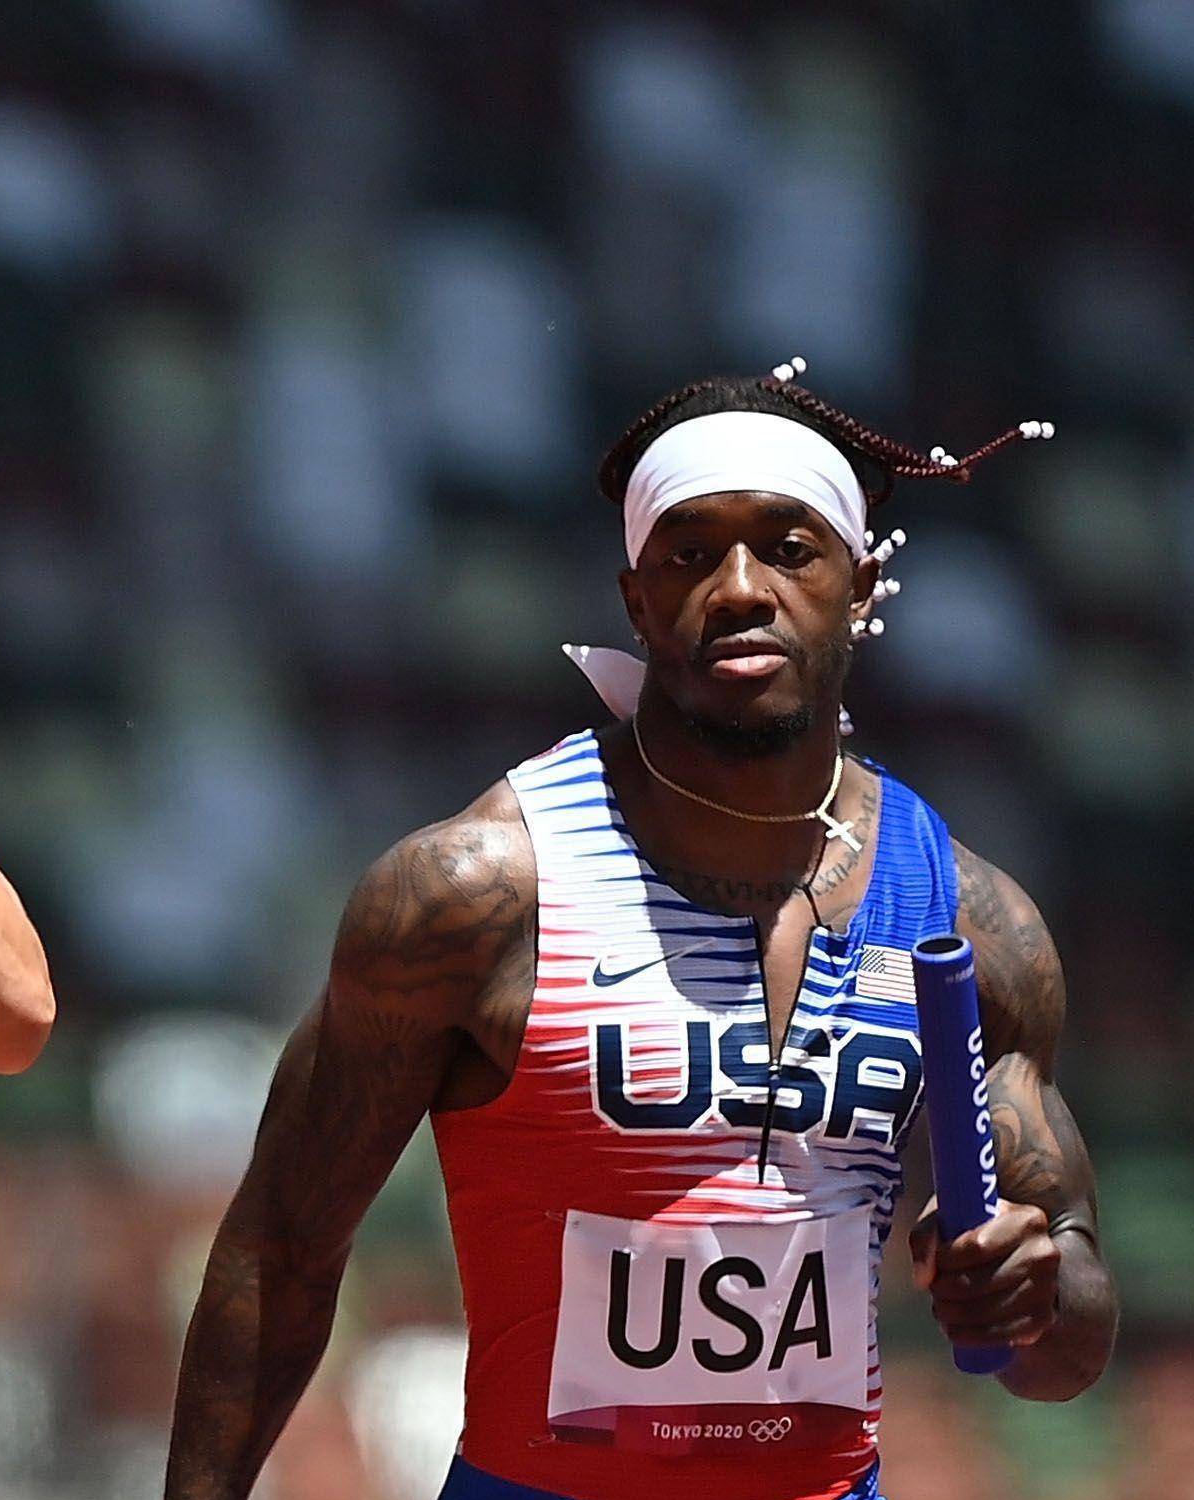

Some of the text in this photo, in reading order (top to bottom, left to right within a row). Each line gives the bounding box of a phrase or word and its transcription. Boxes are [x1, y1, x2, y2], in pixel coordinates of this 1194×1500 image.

[590, 1016, 924, 1145] USA
[607, 1248, 832, 1374] USA
[651, 1421, 744, 1440] TOKYO 2020
